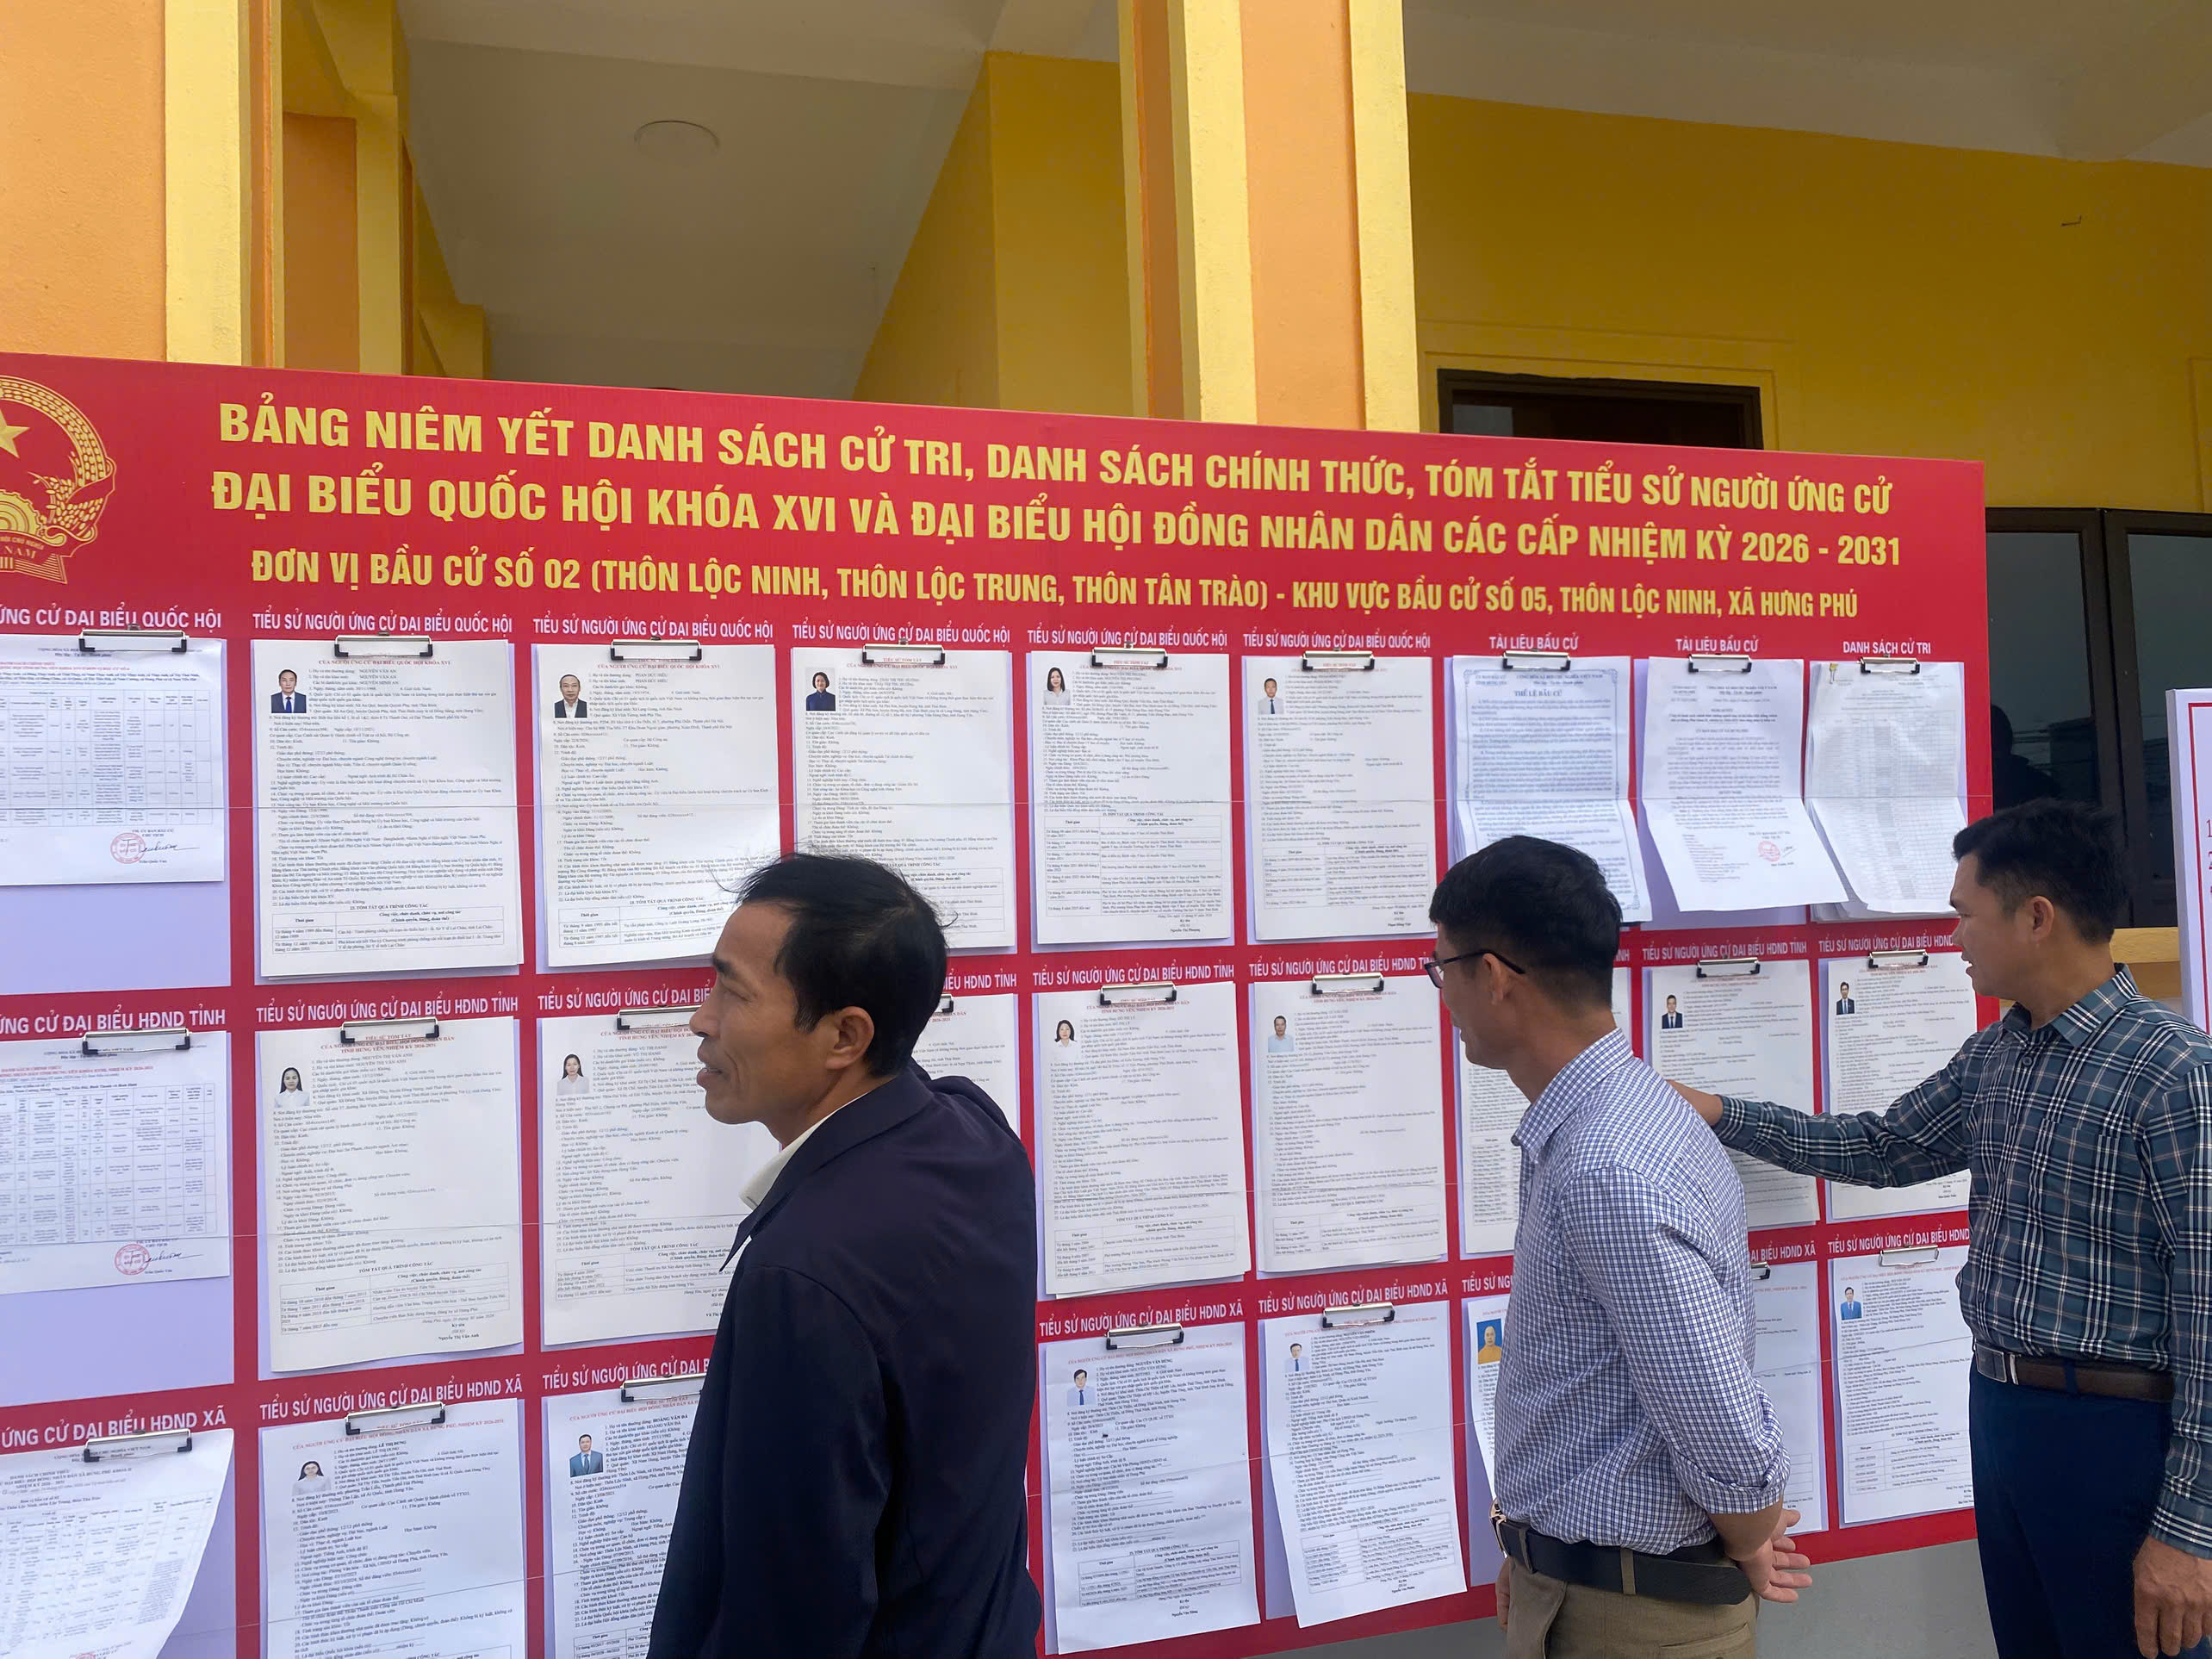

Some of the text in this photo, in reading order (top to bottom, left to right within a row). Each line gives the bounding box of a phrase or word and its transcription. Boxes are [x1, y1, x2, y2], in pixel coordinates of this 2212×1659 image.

[221, 394, 1892, 514] BẢNG NIÊM YẾT DANH SÁCH CỬ TRI, DANH SÁCH CHÍNH THỨC, TÓM TẮT TIỂU SỬ NGƯỜI ỨNG CỬ
[212, 472, 289, 519] ĐẠI
[309, 469, 411, 516] BIỂU
[429, 473, 545, 521] QUỐC
[562, 479, 631, 531] HỘI
[649, 484, 759, 528] KHÓA
[773, 495, 836, 531] XVI
[849, 492, 899, 534] VÀ
[911, 501, 973, 544] ĐẠI
[988, 493, 1070, 541] BIỂU
[1084, 503, 1141, 550] HỘI
[1153, 501, 1248, 546] ĐỒNG
[1261, 511, 1353, 550] NHÂN
[1366, 513, 1432, 551] DÂN
[1445, 516, 1506, 554] CÁC
[1518, 513, 1578, 555] CẤP
[1589, 522, 1686, 564] NHIỆM
[1697, 525, 1732, 560] KỲ
[1742, 532, 1809, 562] 2026
[1838, 536, 1898, 565] 2031
[252, 549, 318, 582] ĐƠN
[330, 553, 358, 590] VỊ
[371, 546, 432, 585] BẦU
[444, 548, 487, 586] CỬ
[494, 550, 533, 587] SỐ
[545, 559, 580, 588] 02
[592, 556, 678, 593] (THÔN
[689, 558, 741, 599] LỘC
[752, 566, 828, 600] NINH,
[837, 564, 907, 598] THÔN
[917, 566, 965, 606] LỘC
[973, 574, 1064, 606] TRUNG,
[1072, 571, 1136, 604] THÔN
[1145, 573, 1190, 605] TÂN
[1199, 575, 1267, 610] TRÀO)
[1293, 582, 1338, 608] KHU
[1346, 581, 1389, 614] VỰC
[1398, 575, 1441, 609] BẦU
[1450, 576, 1480, 610] CỬ
[1486, 577, 1513, 611] SỐ
[1521, 587, 1552, 614] 05,
[1560, 582, 1614, 612] THÔN
[1622, 583, 1659, 618] LỘC
[1667, 589, 1721, 618] NINH,
[1729, 587, 1755, 615] XÃ
[1762, 590, 1813, 616] HƯNG
[1820, 589, 1857, 617] PHÚ
[36, 606, 60, 624] CỬ
[143, 606, 189, 631] QUỐC
[195, 609, 221, 631] HỘI
[253, 608, 280, 629] TIỂU
[285, 608, 302, 629] SỬ
[306, 611, 345, 630] NGƯỜI
[349, 612, 375, 631] ỨNG
[379, 610, 396, 633] CỬ
[425, 611, 450, 631] BIỂU
[455, 612, 488, 632] QUỐC
[493, 614, 512, 636] HỘI
[533, 613, 558, 633] TIỂU
[562, 613, 579, 634] SỬ
[582, 616, 618, 634] NGƯỜI
[622, 617, 646, 635] ỨNG
[650, 616, 667, 636] CỬ
[693, 616, 716, 637] BIỂU
[720, 617, 751, 637] QUỐC
[755, 620, 773, 637] HỘI
[1489, 634, 1507, 649] TÀI
[1538, 632, 1559, 649] BẦU
[1563, 633, 1578, 649] CỬ
[1676, 637, 1692, 650] TÀI
[1720, 635, 1740, 651] BẦU
[1743, 636, 1758, 651] CỬ
[1843, 638, 1930, 654] DANH SÁCH CỬ TRI
[34, 1010, 59, 1033] CỬ
[97, 1005, 133, 1029] BIỂU
[140, 1011, 183, 1028] HĐND
[190, 1003, 225, 1025] TỈNH
[257, 998, 283, 1022] TIỂU
[288, 1000, 305, 1021] SỬ
[308, 1000, 346, 1020] NGƯỜI
[351, 999, 376, 1018] ỨNG
[426, 992, 450, 1015] BIỂU
[455, 998, 488, 1013] HĐND
[492, 991, 518, 1012] TỈNH
[1040, 1314, 1060, 1336] TIỂU
[1065, 1314, 1078, 1333] SỬ
[1081, 1313, 1112, 1332] NGƯỜI
[1115, 1312, 1136, 1329] ỨNG
[1176, 1301, 1196, 1323] BIỂU
[1200, 1304, 1226, 1319] HĐND
[1230, 1299, 1243, 1316] XÃ
[260, 1395, 288, 1420] TIỂU
[293, 1394, 310, 1416] SỬ
[314, 1392, 354, 1414] NGƯỜI
[358, 1389, 385, 1409] ỨNG
[437, 1377, 463, 1401] BIỂU
[468, 1380, 500, 1397] HĐND
[506, 1374, 522, 1393] XÃ
[2, 1427, 38, 1447] ỨNG
[45, 1420, 69, 1443] CỬ
[203, 1406, 226, 1426] XÃ
